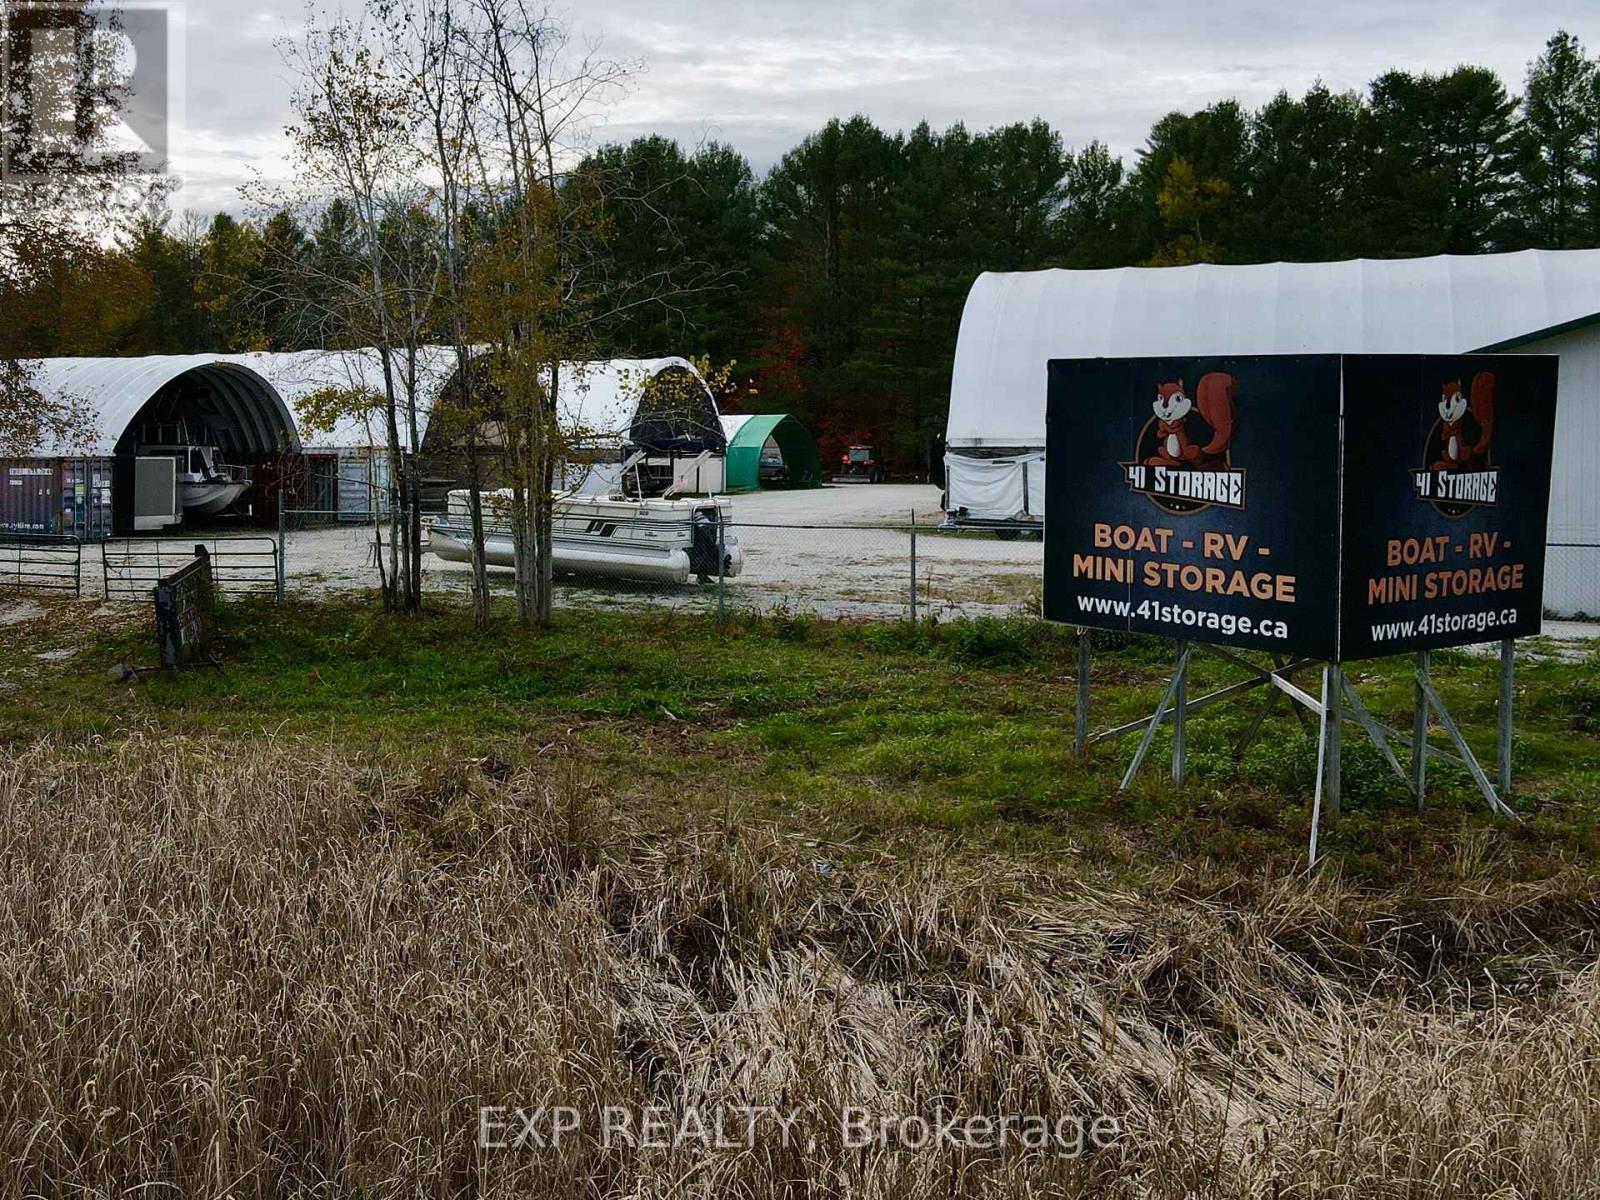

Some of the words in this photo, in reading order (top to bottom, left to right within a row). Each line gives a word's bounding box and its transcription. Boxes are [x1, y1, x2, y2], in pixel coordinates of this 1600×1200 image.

[1128, 466, 1145, 489] 41
[1155, 466, 1242, 505] STORAGE
[1416, 473, 1430, 496] 41
[1437, 469, 1497, 502] STORAGE
[1094, 523, 1174, 554] BOAT
[1203, 532, 1248, 561] RV
[1387, 535, 1450, 566] BOAT
[1469, 532, 1499, 559] RV
[1073, 553, 1135, 584] MINI
[1143, 558, 1296, 603] STORAGE
[1368, 574, 1417, 605] MINI
[1424, 563, 1524, 600] STORAGE
[1077, 594, 1289, 639] www.41storage.ca
[1371, 607, 1517, 642] www.41storage.ca
